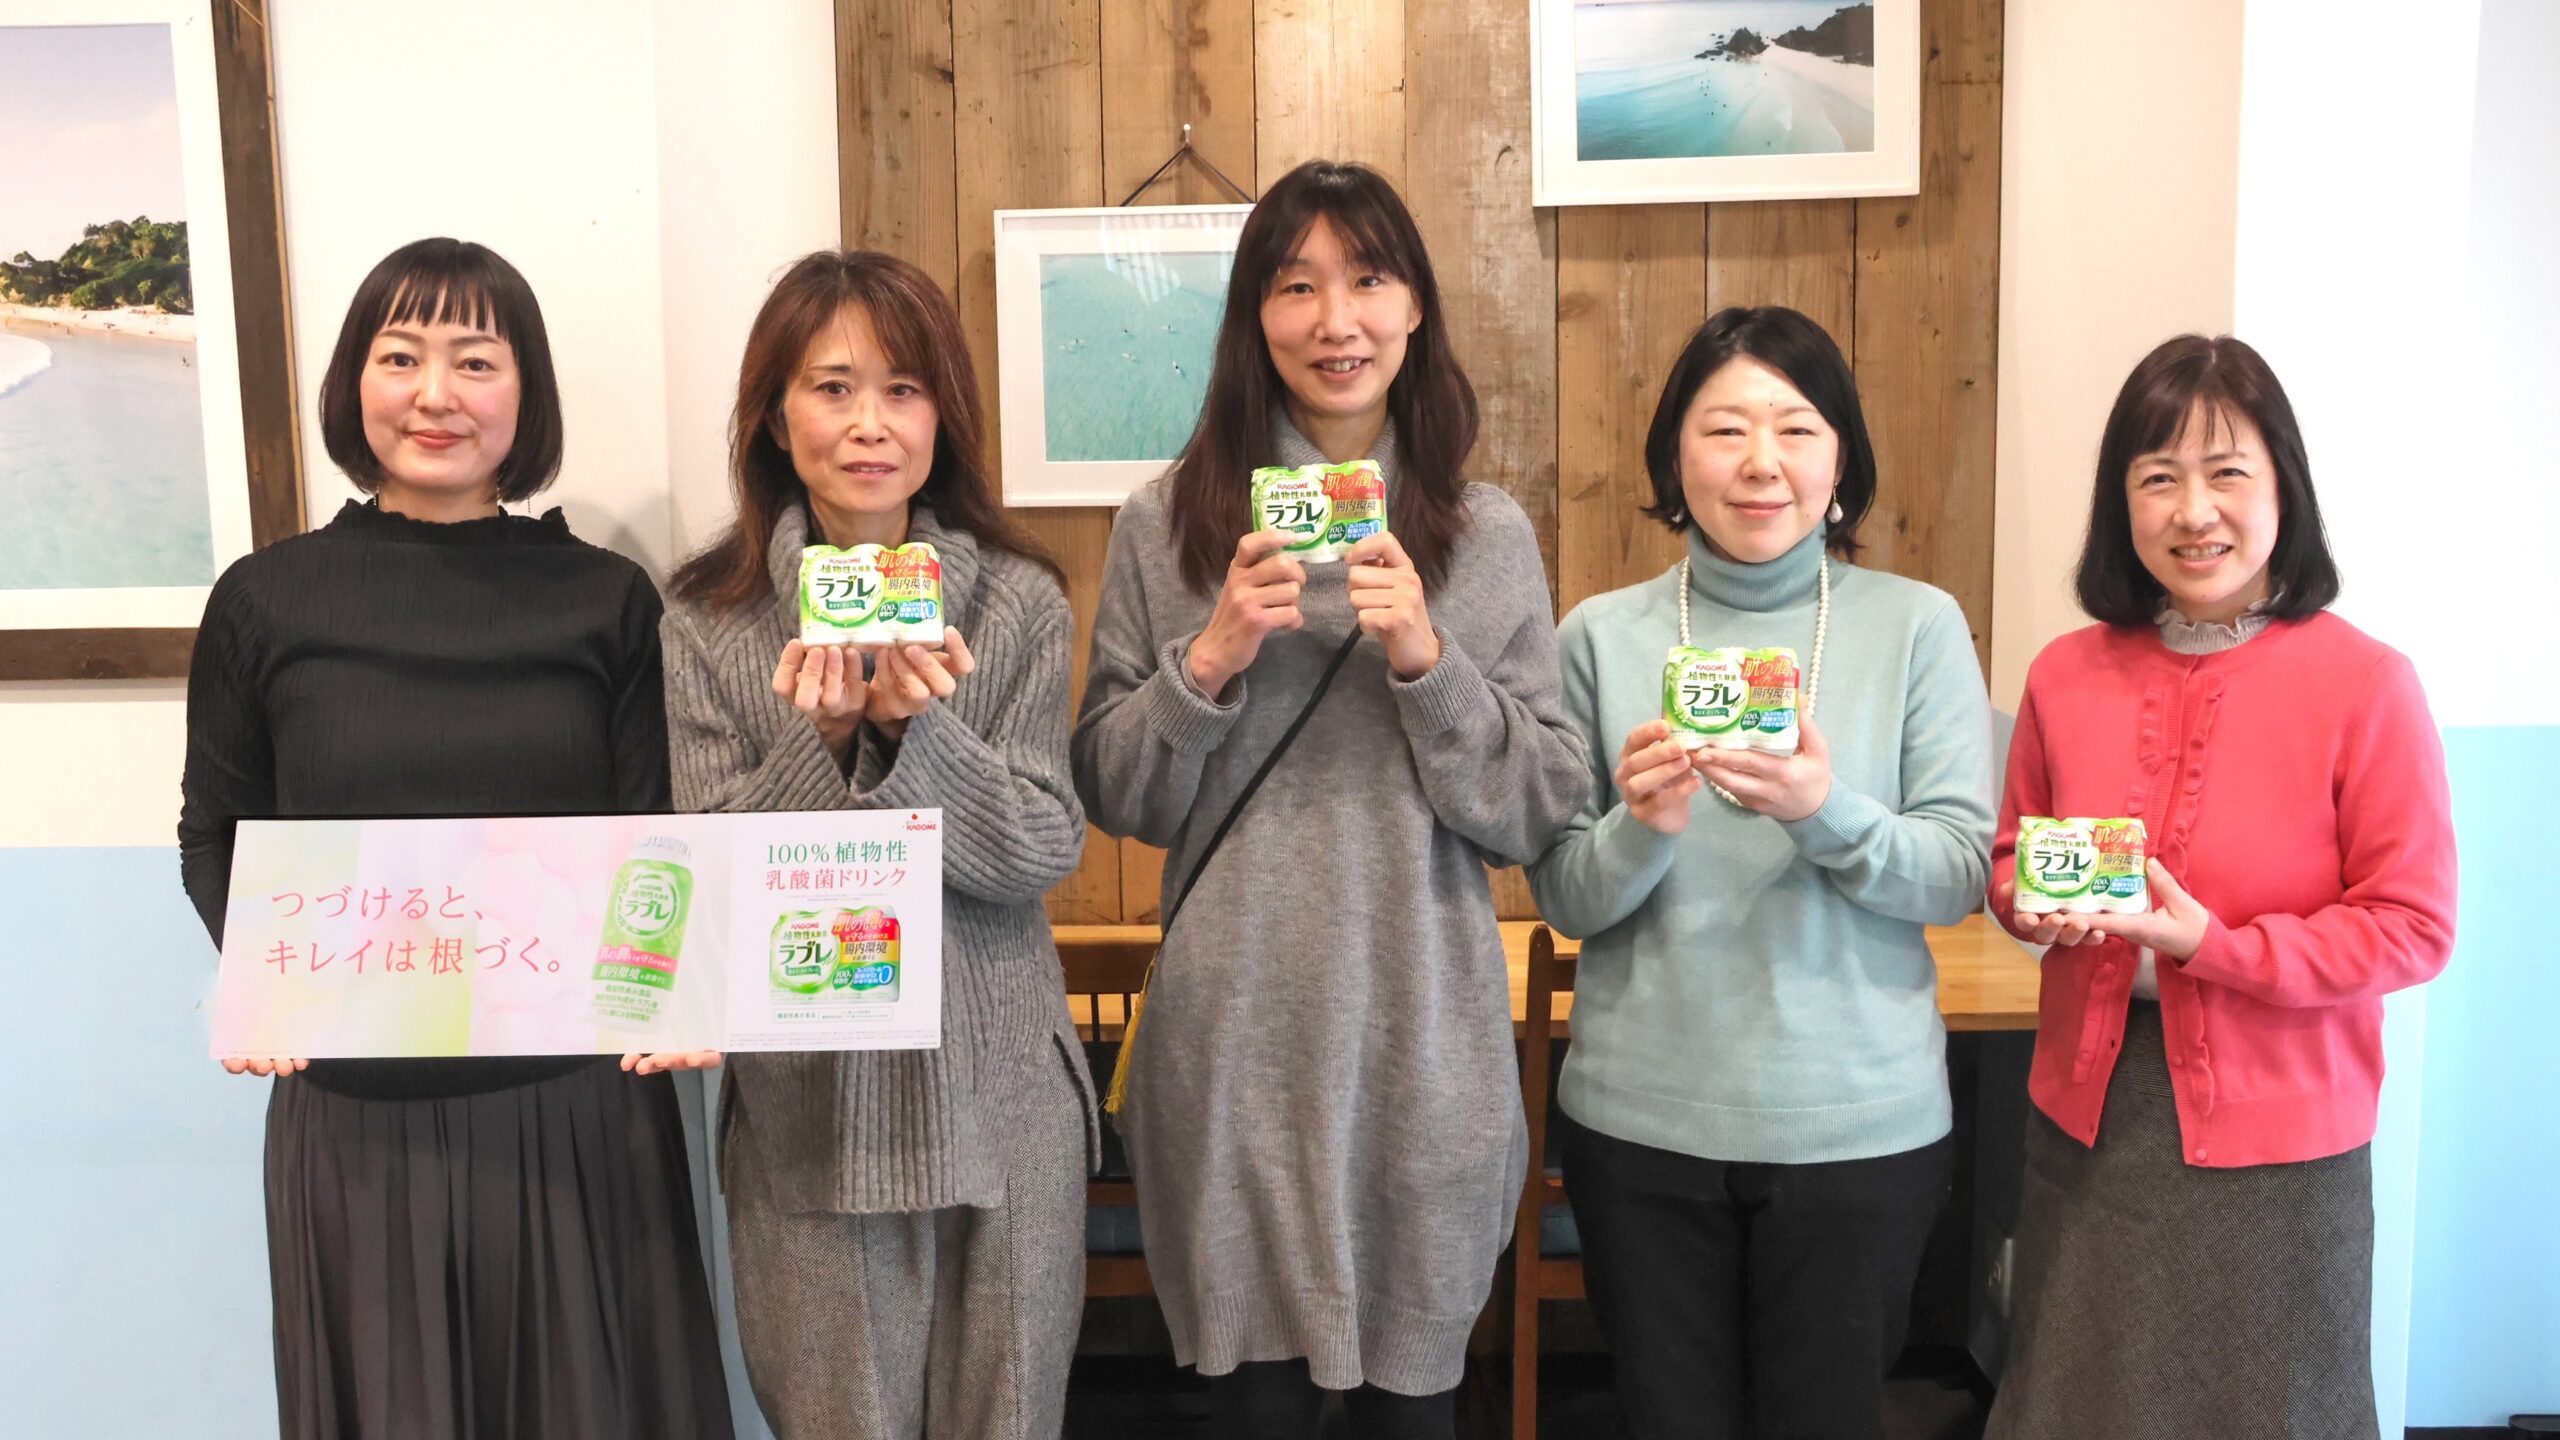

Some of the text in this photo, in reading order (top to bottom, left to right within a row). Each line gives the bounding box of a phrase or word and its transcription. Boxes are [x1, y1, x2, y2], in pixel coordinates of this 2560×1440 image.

[1270, 491, 1318, 500] 植物性乳酸菌
[1336, 500, 1376, 512] 腸内環境
[1266, 501, 1324, 525] ラブレ
[816, 576, 876, 598] ラブレ
[888, 578, 931, 590] 腸内環境
[1682, 683, 1741, 706] ラブレ
[906, 823, 937, 831] KAGOME
[767, 840, 908, 864] 100%植物性
[2033, 850, 2092, 870] ラブレ
[765, 868, 907, 890] 乳酸菌ドリンク
[272, 885, 484, 921] つづけると、
[625, 900, 670, 921] ラブレ
[265, 936, 560, 975] キレイは根づく。
[779, 941, 833, 965] ラブレ
[844, 942, 888, 955] 腸内環境
